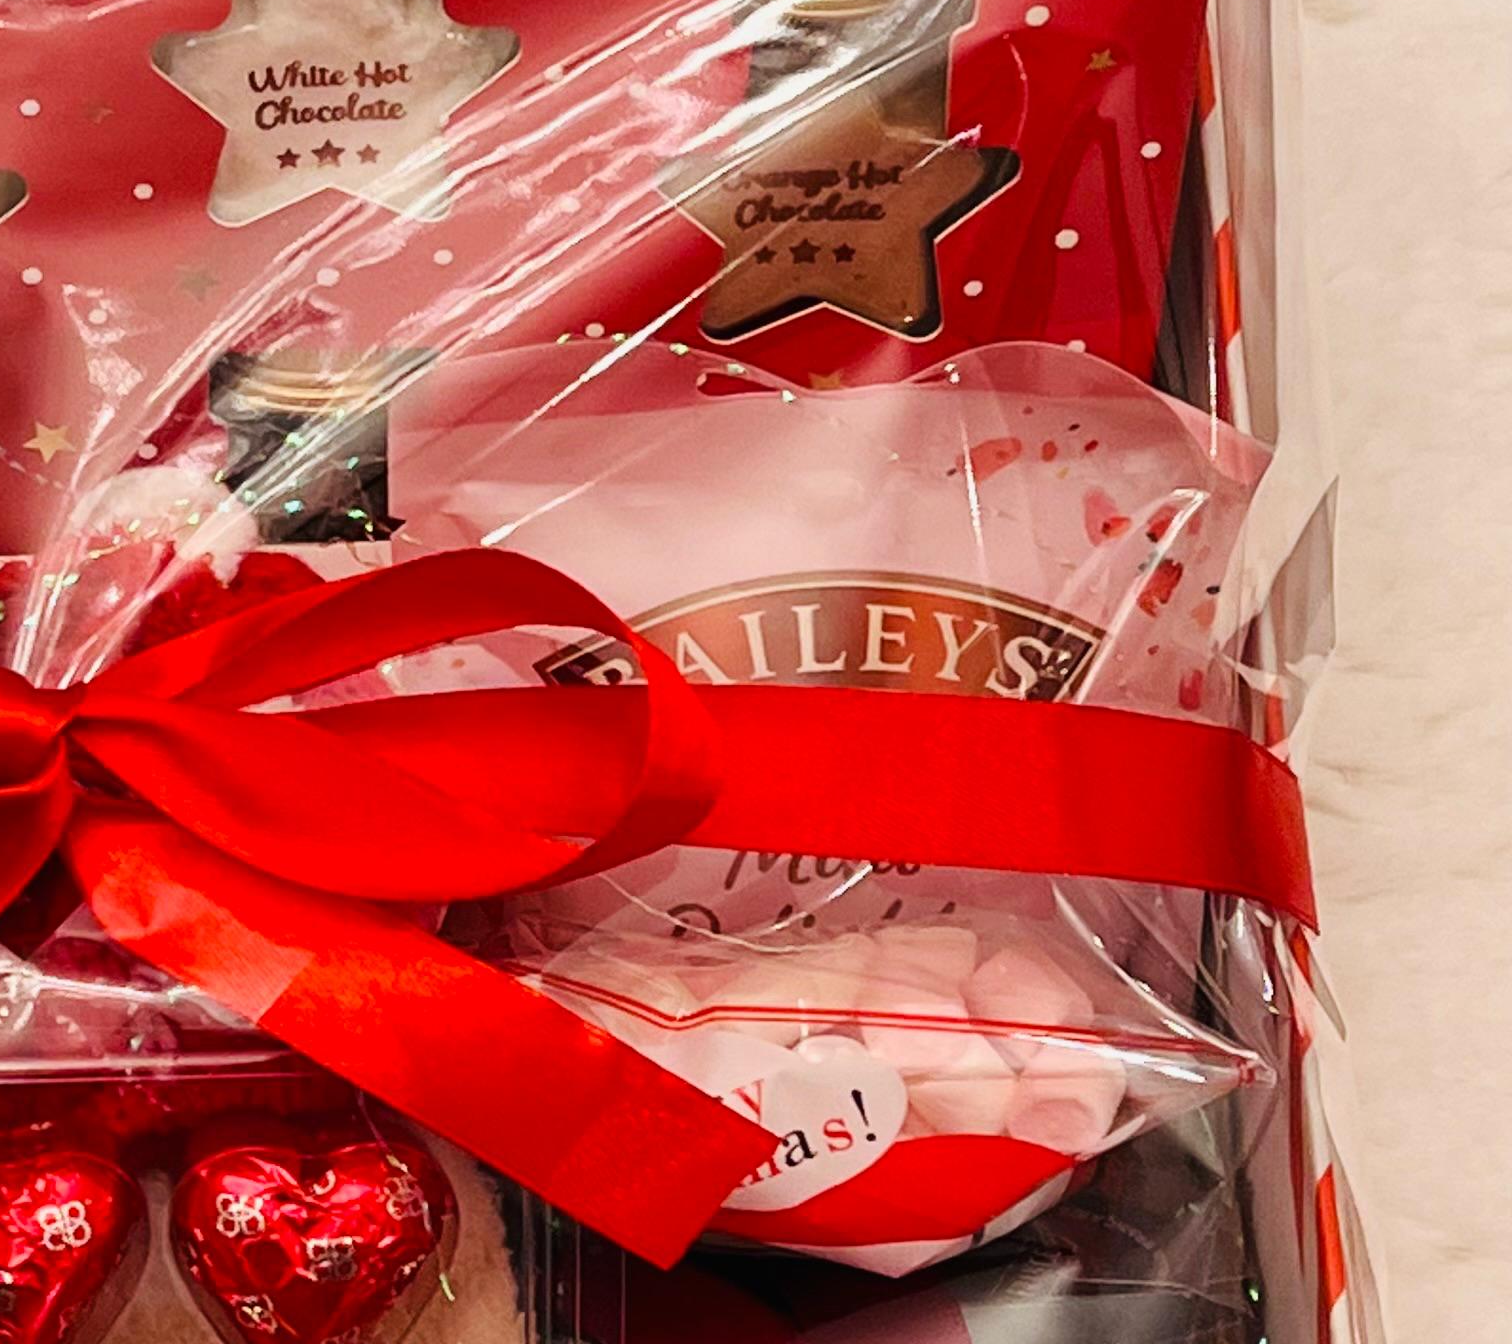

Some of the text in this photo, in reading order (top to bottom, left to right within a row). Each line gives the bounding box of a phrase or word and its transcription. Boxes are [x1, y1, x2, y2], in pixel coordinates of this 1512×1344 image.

[248, 60, 413, 93] White Hot
[255, 92, 407, 131] Chocolate
[845, 160, 905, 190] Hot
